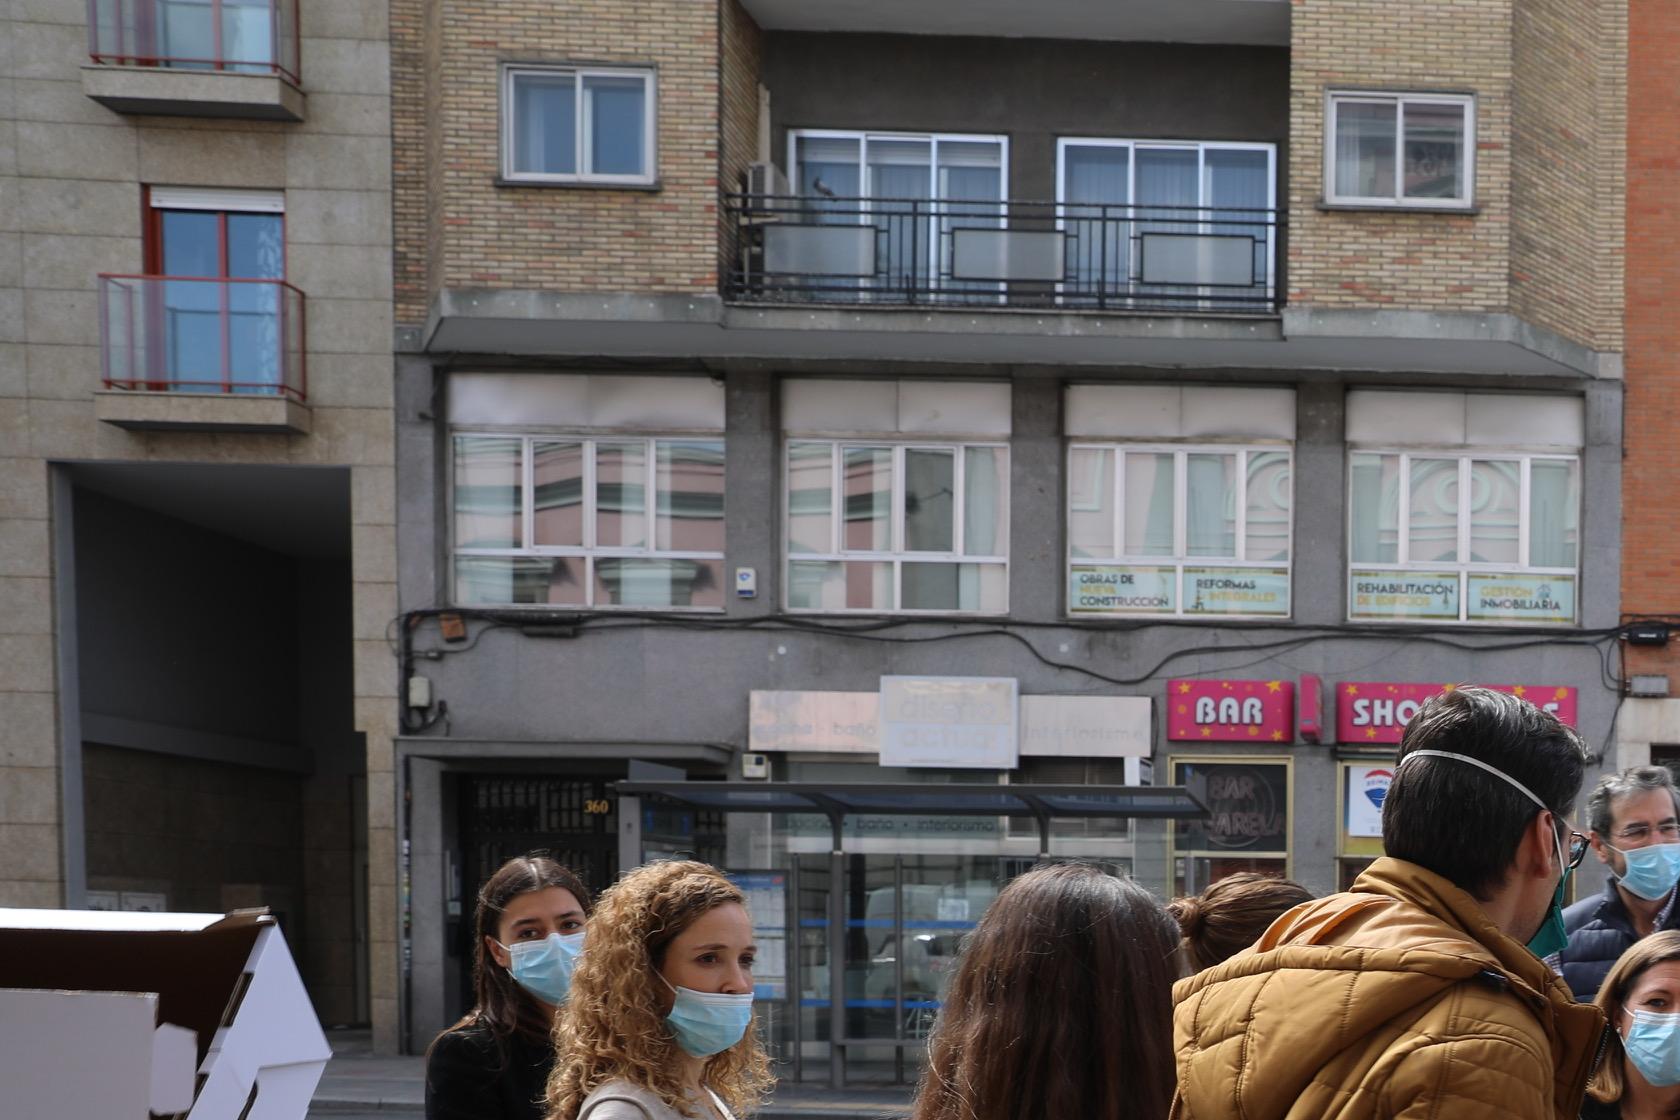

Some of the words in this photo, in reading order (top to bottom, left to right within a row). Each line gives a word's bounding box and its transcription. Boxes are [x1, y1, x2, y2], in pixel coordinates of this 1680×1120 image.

[1080, 574, 1118, 584] OBRAS
[1120, 574, 1135, 584] DE
[1196, 579, 1256, 590] REFORMAS
[1356, 582, 1453, 595] REHABILITACIÓN
[1480, 599, 1560, 610] INMOBILIARIA
[1195, 697, 1264, 725] BAR
[1352, 698, 1420, 727] SHO
[1208, 776, 1255, 800] BAR
[584, 800, 609, 814] 360
